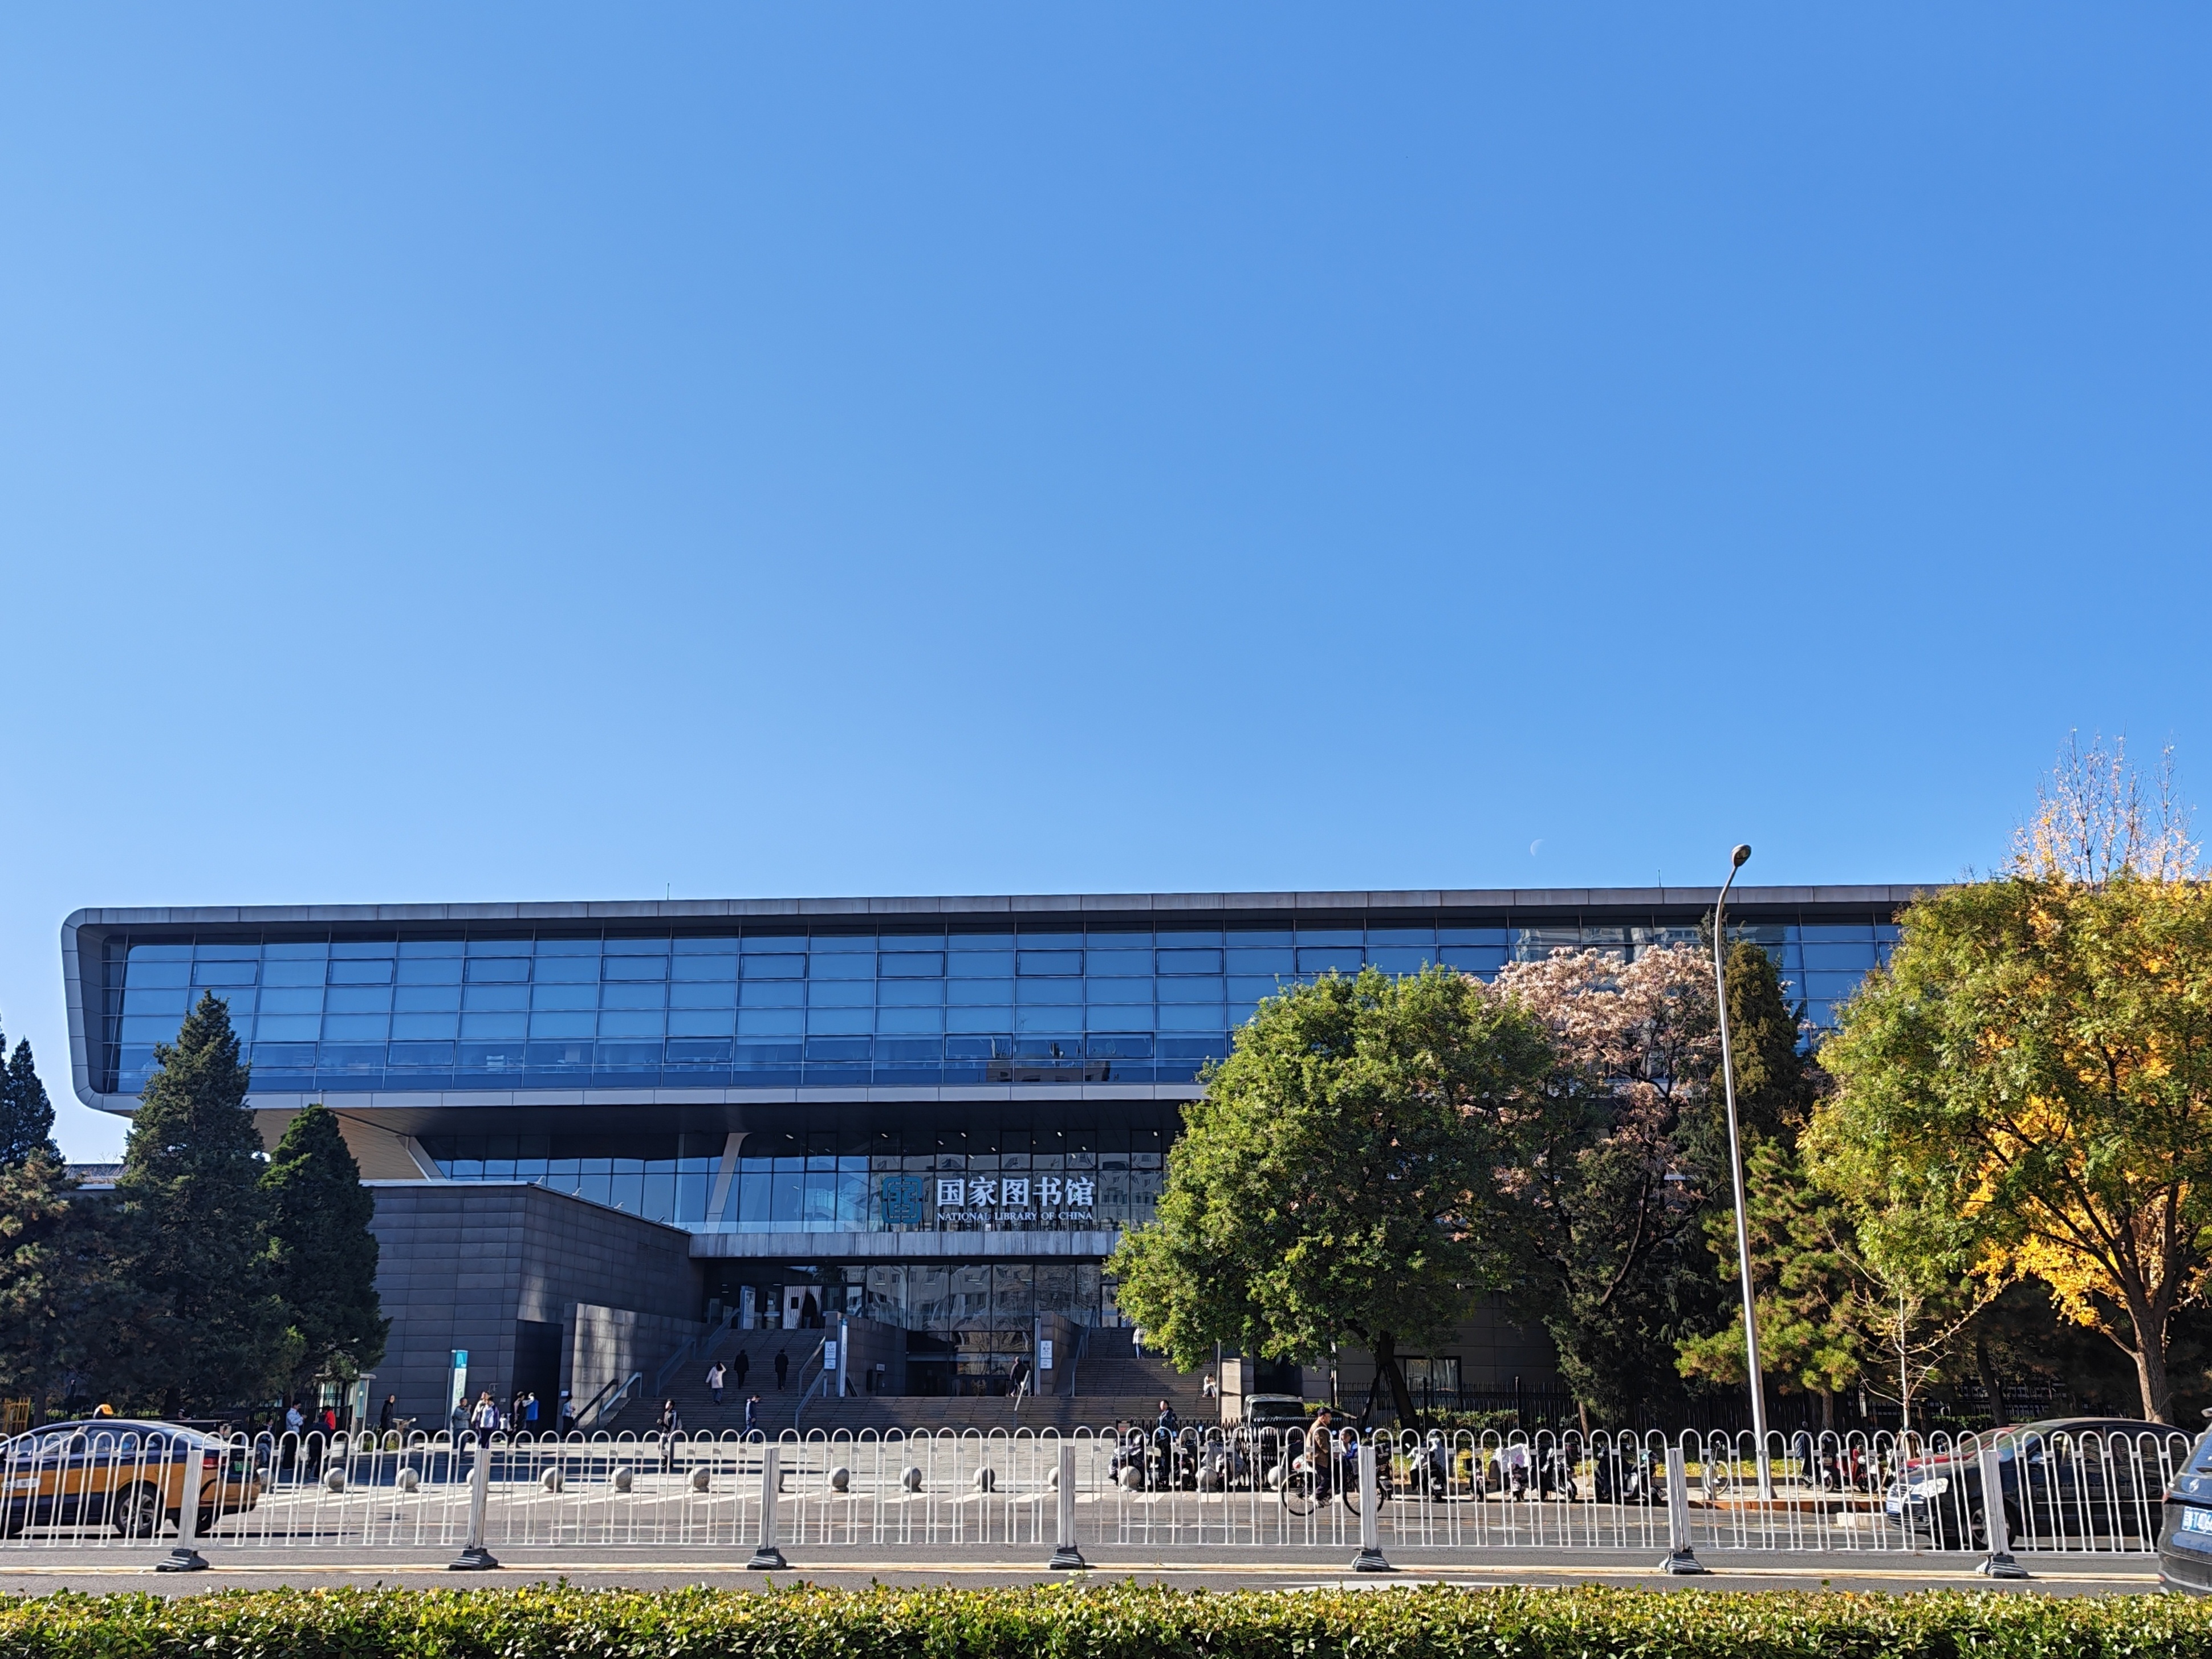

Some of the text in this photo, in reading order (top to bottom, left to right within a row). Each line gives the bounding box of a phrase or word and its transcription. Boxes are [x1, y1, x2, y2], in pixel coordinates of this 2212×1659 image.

[937, 1176, 1095, 1207] 国家图书馆
[937, 1212, 1093, 1221] NATIONAL LIBRARY OF CHINA
